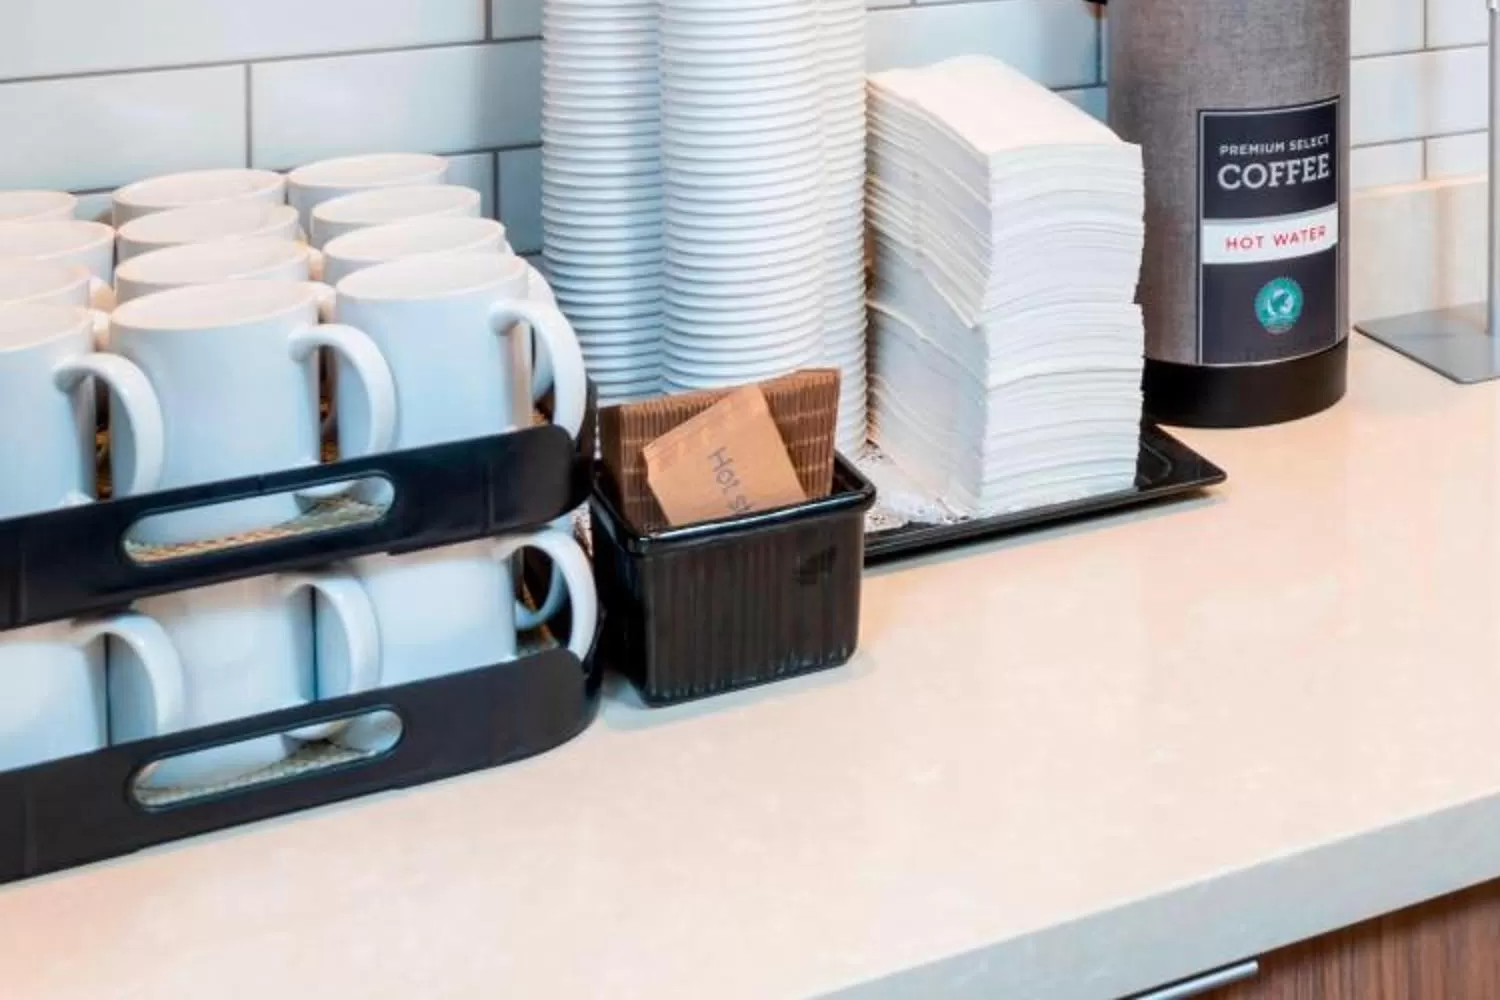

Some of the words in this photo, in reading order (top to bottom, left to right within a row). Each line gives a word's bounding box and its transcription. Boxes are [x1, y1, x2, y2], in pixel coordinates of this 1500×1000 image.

[1219, 141, 1285, 156] PREMIUM
[1289, 133, 1329, 151] SELECT
[1217, 152, 1330, 190] COFFEE
[1225, 234, 1265, 250] HOT
[1273, 224, 1327, 247] WATER
